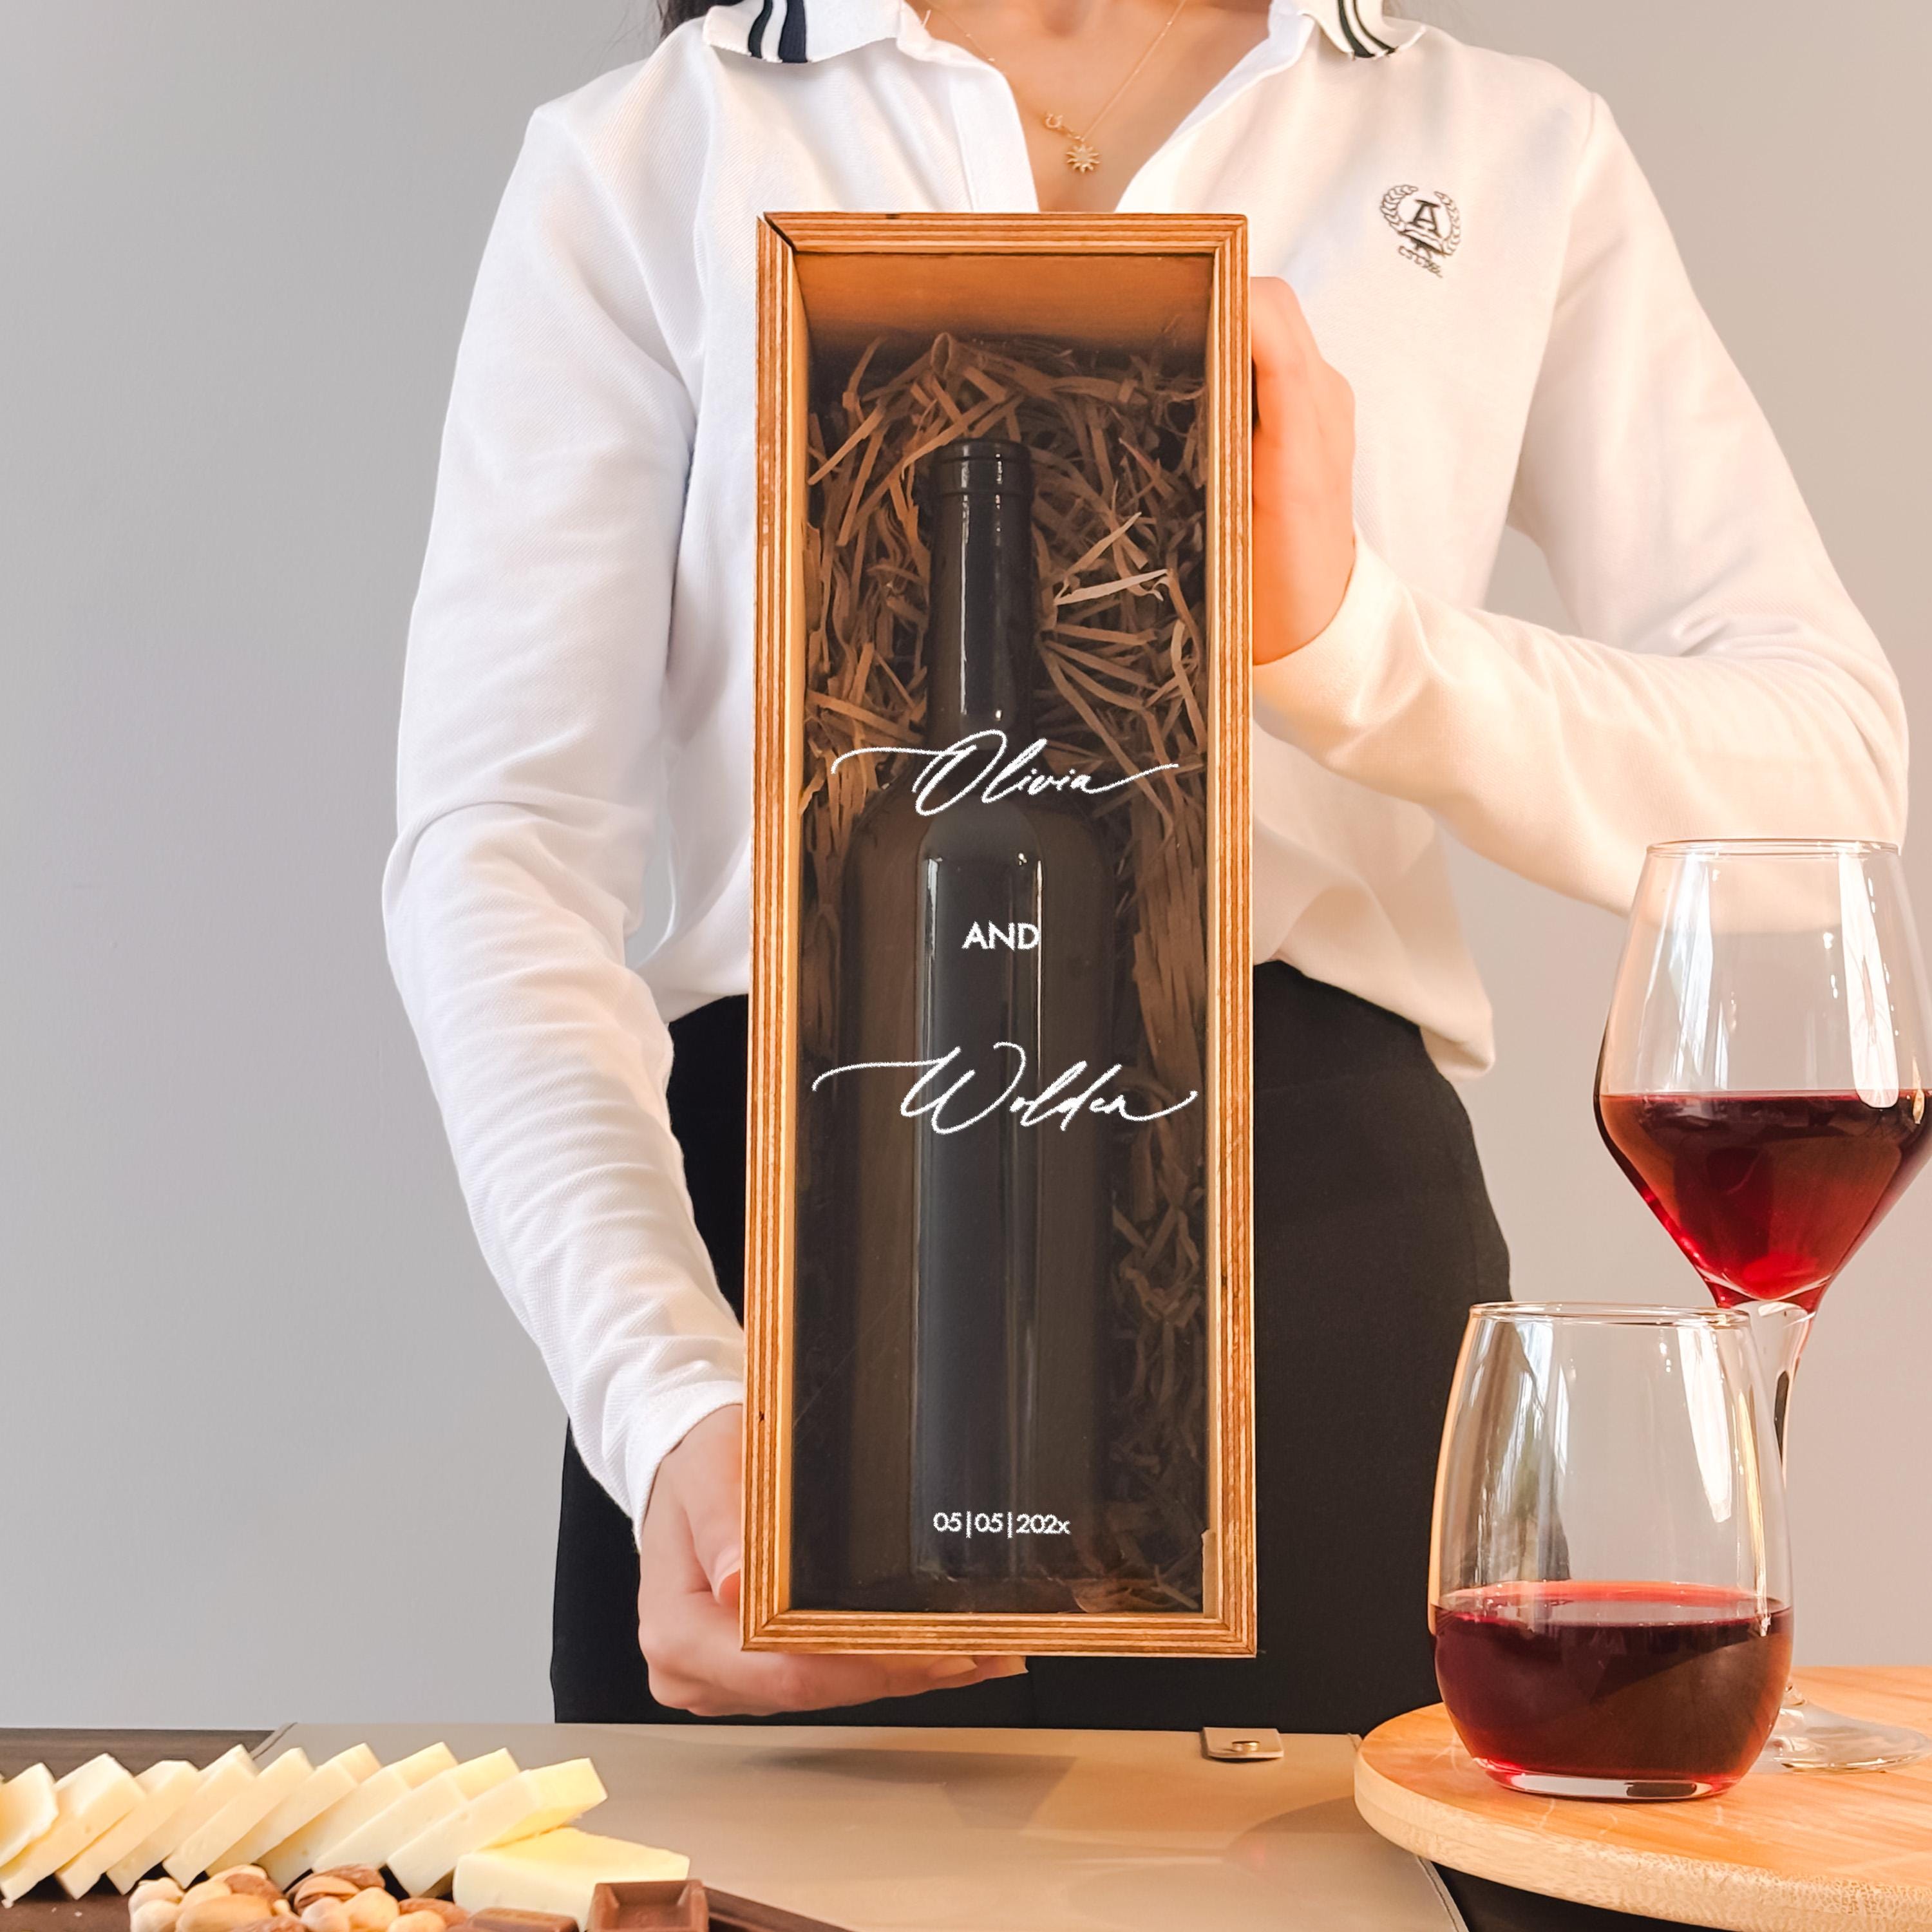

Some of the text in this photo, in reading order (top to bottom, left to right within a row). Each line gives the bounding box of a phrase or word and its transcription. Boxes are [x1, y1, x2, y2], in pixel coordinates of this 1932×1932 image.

[831, 729, 1179, 817] Olivia
[961, 922, 1040, 950] AND
[933, 1511, 1072, 1539] 05|05|202x
